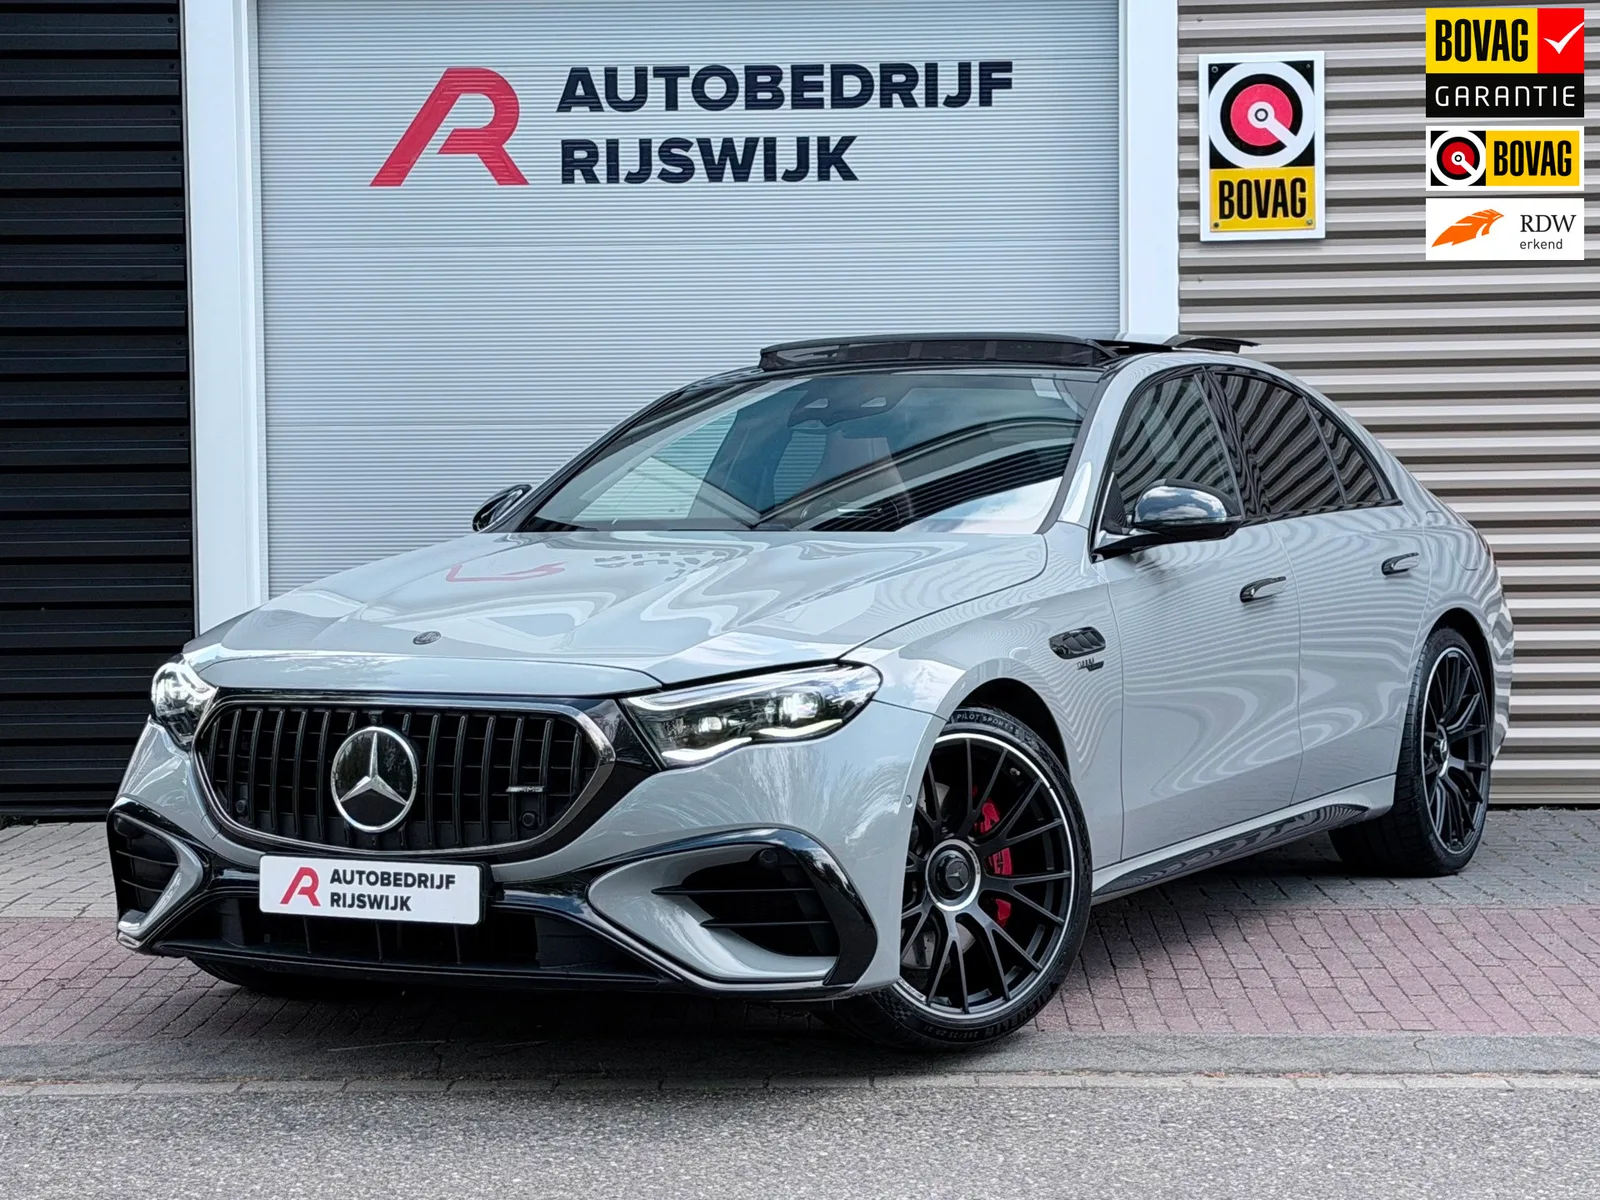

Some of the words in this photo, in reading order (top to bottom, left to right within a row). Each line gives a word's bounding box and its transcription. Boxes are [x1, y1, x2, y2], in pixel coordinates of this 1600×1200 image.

[556, 61, 1014, 113] AUTOBEDRIJF
[560, 135, 860, 186] RIJSWIJK
[1217, 176, 1308, 221] BOVAG
[329, 868, 457, 890] AUTOBEDRIJF
[329, 891, 413, 912] RIJSWIJK
